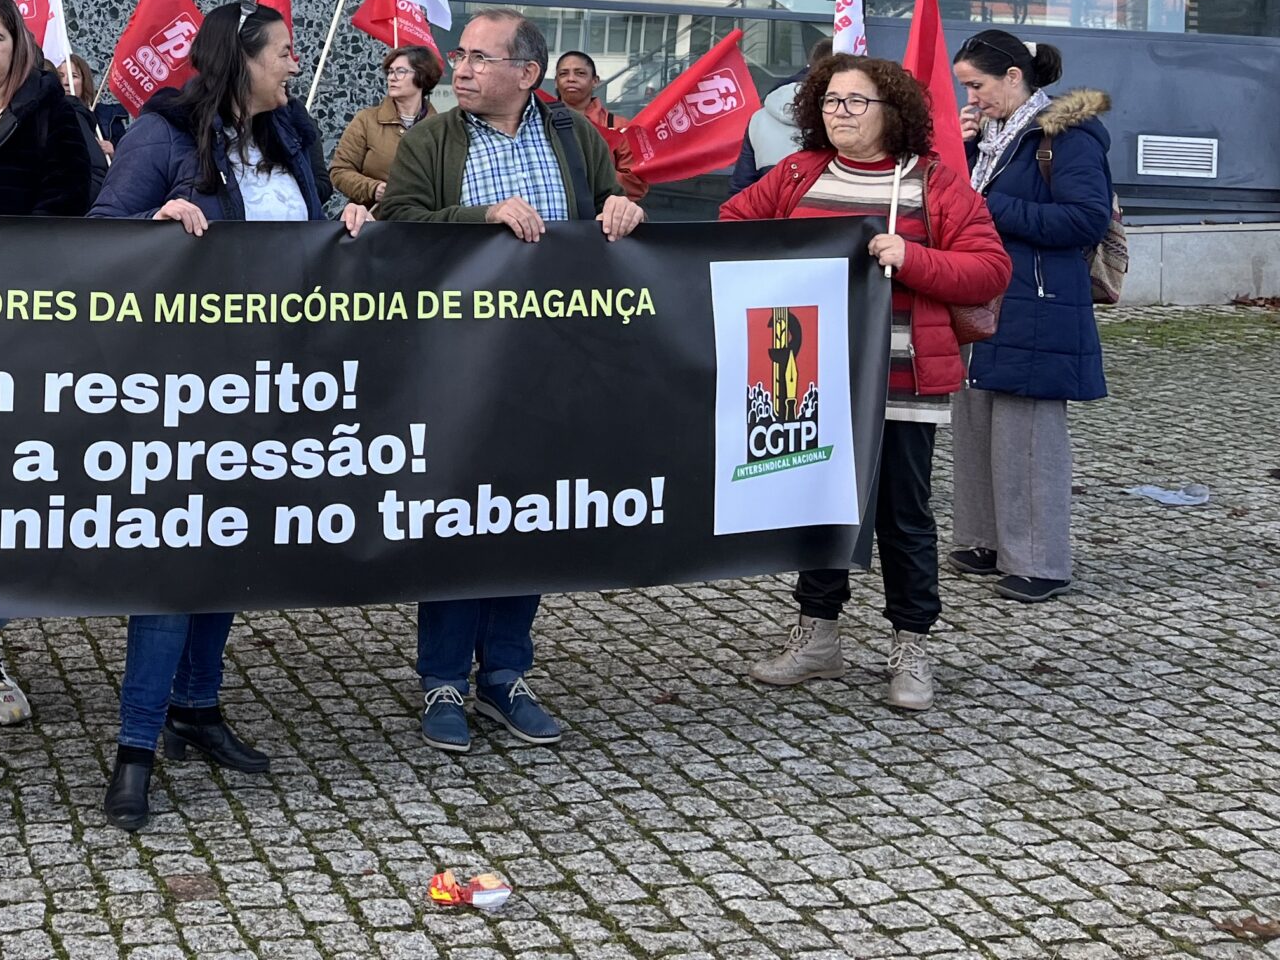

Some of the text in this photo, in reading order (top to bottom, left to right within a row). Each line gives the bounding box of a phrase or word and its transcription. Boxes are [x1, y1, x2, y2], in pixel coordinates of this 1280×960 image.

[122, 57, 154, 92] norte
[90, 291, 142, 322] DA
[155, 286, 408, 324] MISERICÓRDIA
[417, 291, 462, 320] DE
[473, 287, 656, 324] BRAGANÇA
[44, 360, 359, 428] respeito!
[749, 420, 817, 458] CGTP
[12, 440, 59, 482] a
[83, 422, 426, 495] opressão!
[737, 450, 827, 477] INTERSINDICAL NACIONAL
[274, 503, 356, 545] no
[377, 476, 665, 541] trabalho!
